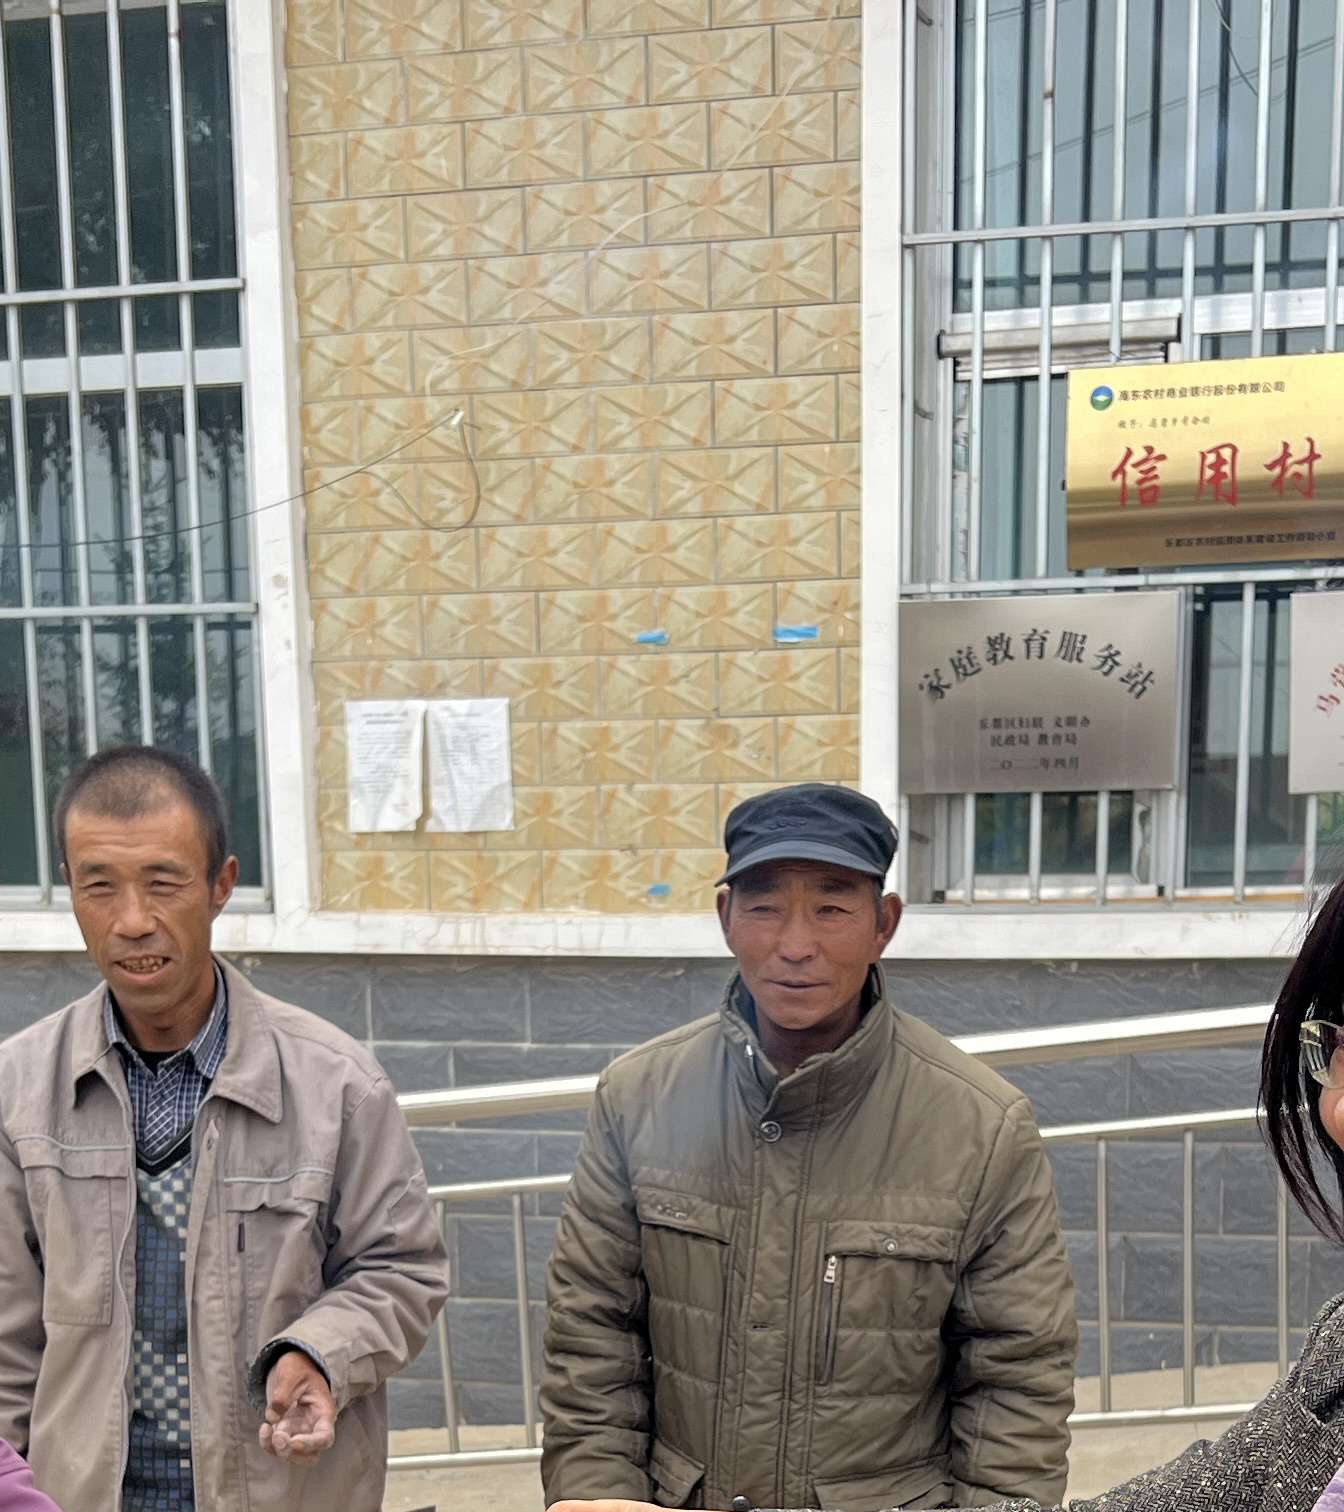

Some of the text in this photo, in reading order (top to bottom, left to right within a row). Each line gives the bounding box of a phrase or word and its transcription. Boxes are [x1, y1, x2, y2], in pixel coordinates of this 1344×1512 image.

[1110, 437, 1323, 509] 信用村
[918, 628, 1156, 704] 家庭教育服务站
